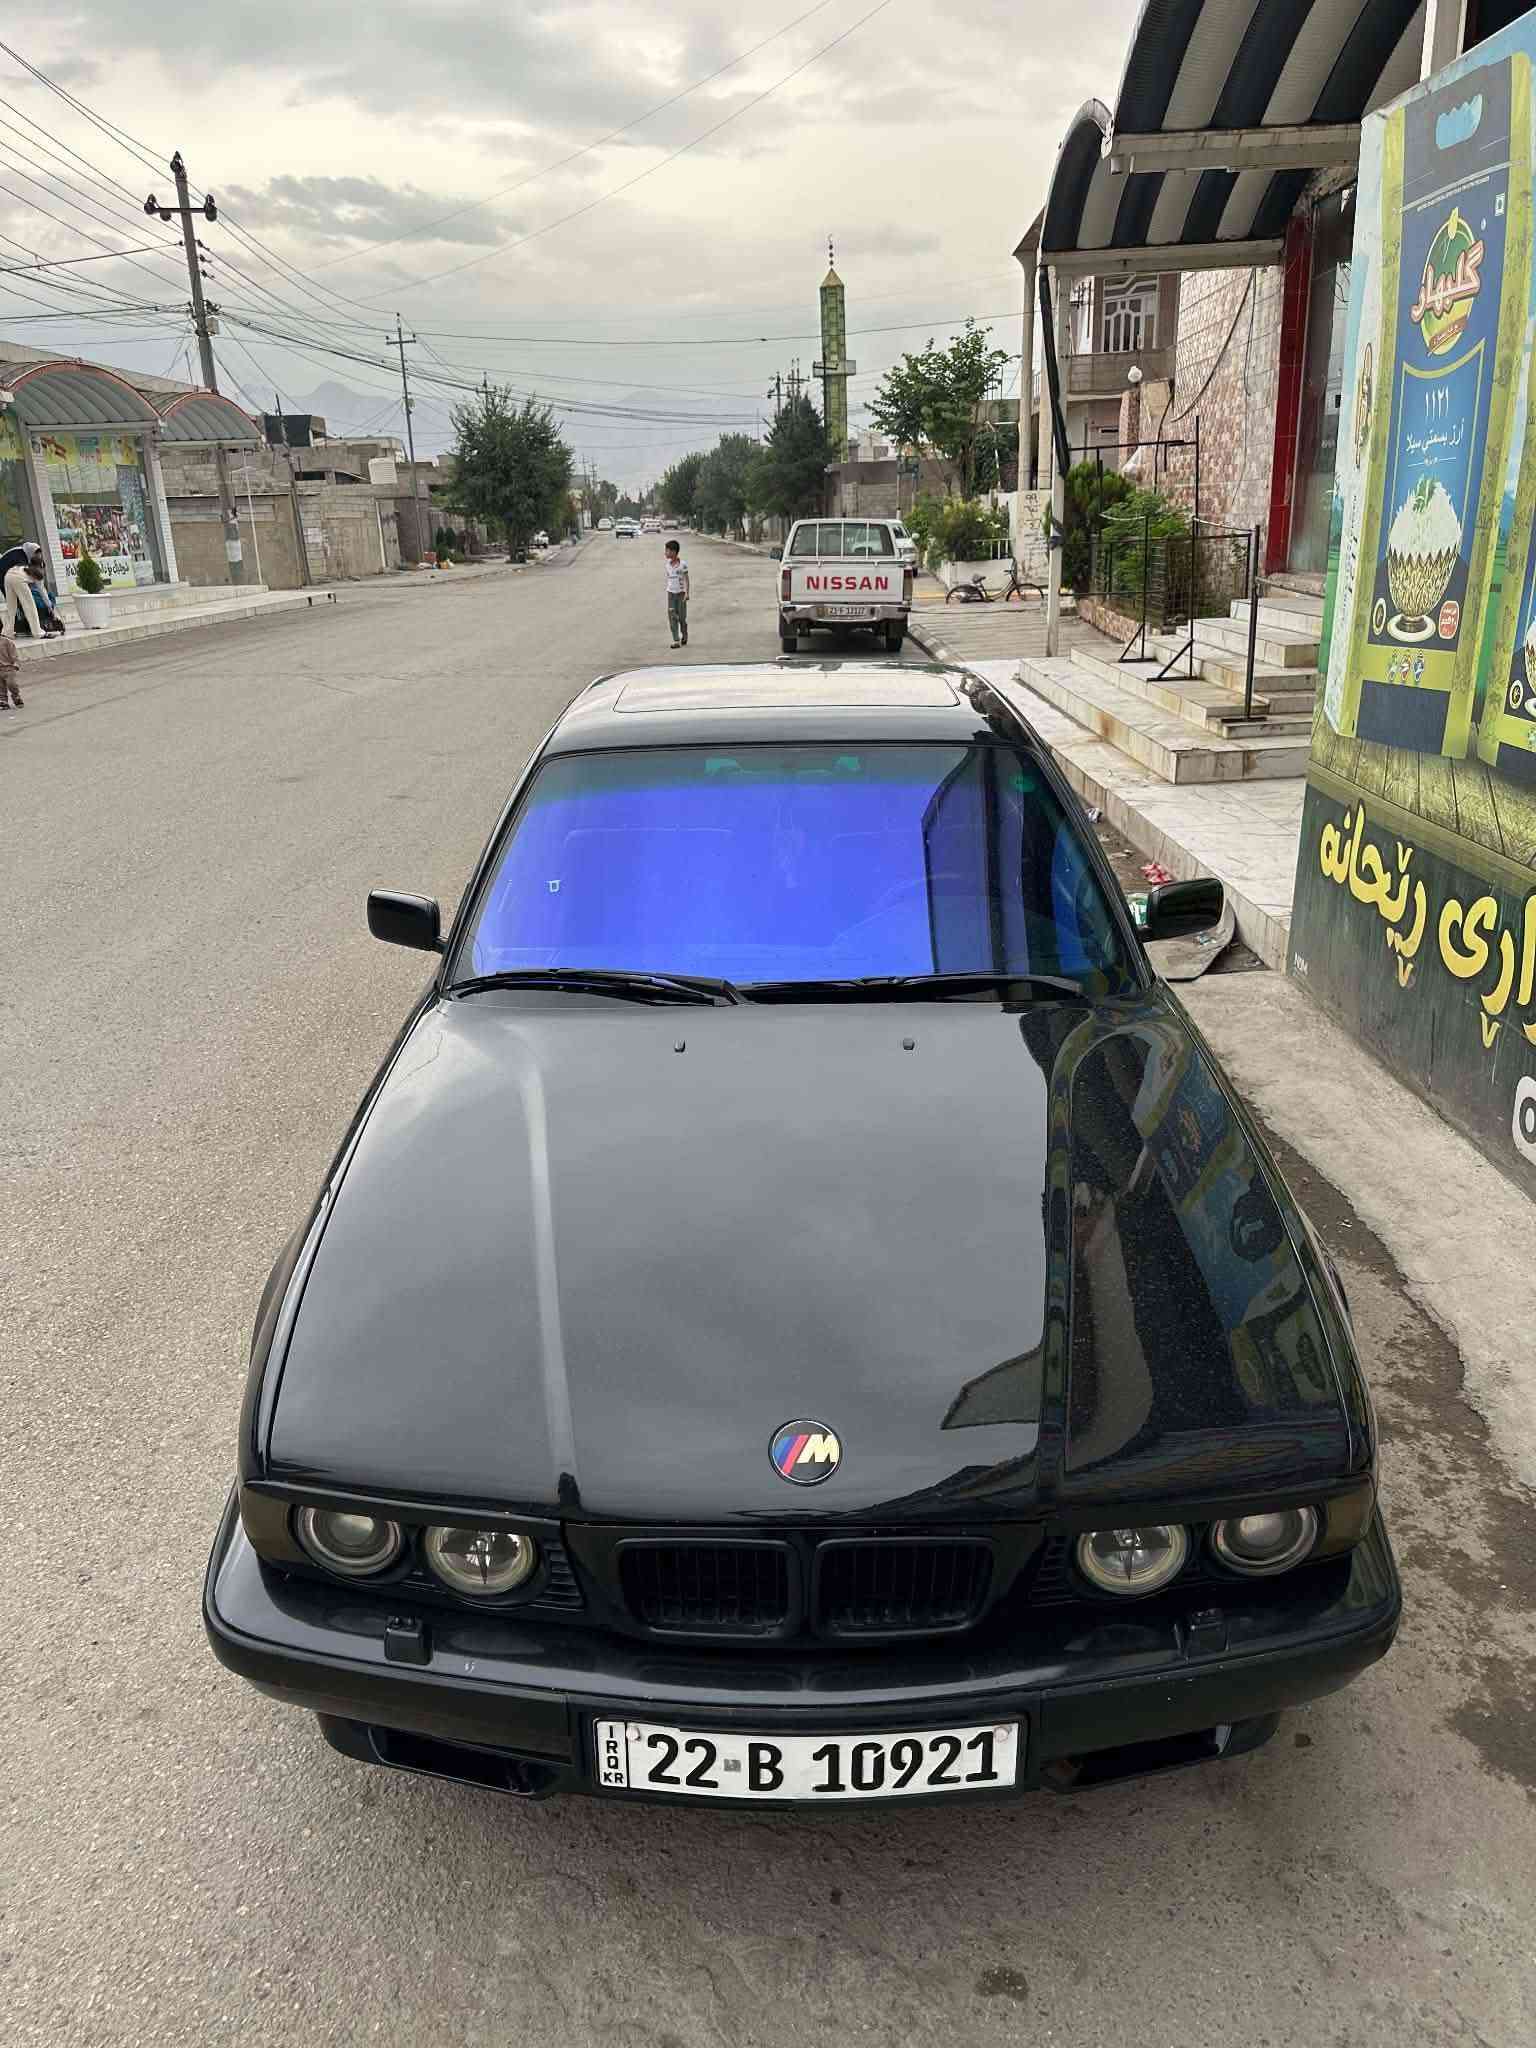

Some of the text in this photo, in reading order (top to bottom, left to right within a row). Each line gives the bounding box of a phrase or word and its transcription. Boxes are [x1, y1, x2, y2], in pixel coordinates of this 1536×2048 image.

[806, 575, 889, 591] NISSAN
[646, 1731, 998, 1793] 22 B 10921
